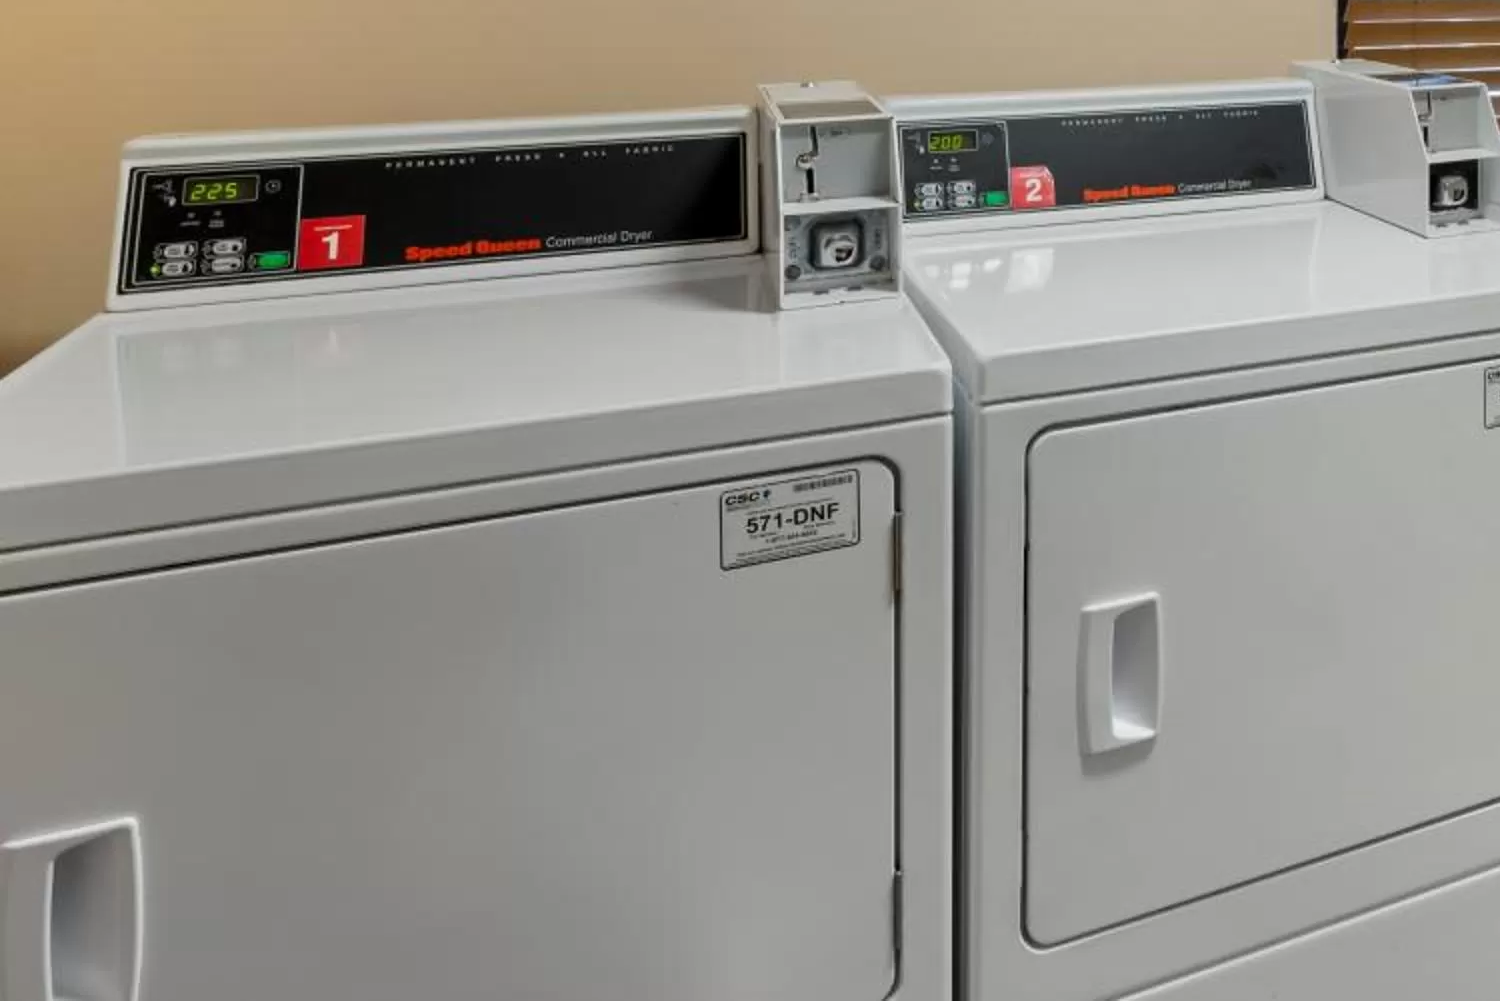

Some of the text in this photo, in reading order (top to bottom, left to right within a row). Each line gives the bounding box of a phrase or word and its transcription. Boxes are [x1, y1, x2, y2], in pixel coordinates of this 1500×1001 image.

[929, 134, 964, 150] 200
[191, 182, 237, 200] 225
[1024, 177, 1043, 203] 2
[321, 230, 340, 261] 1
[405, 230, 653, 262] Speed Queen Commercial Dryer
[725, 491, 761, 506] CSC
[746, 502, 840, 534] 571-DNF
